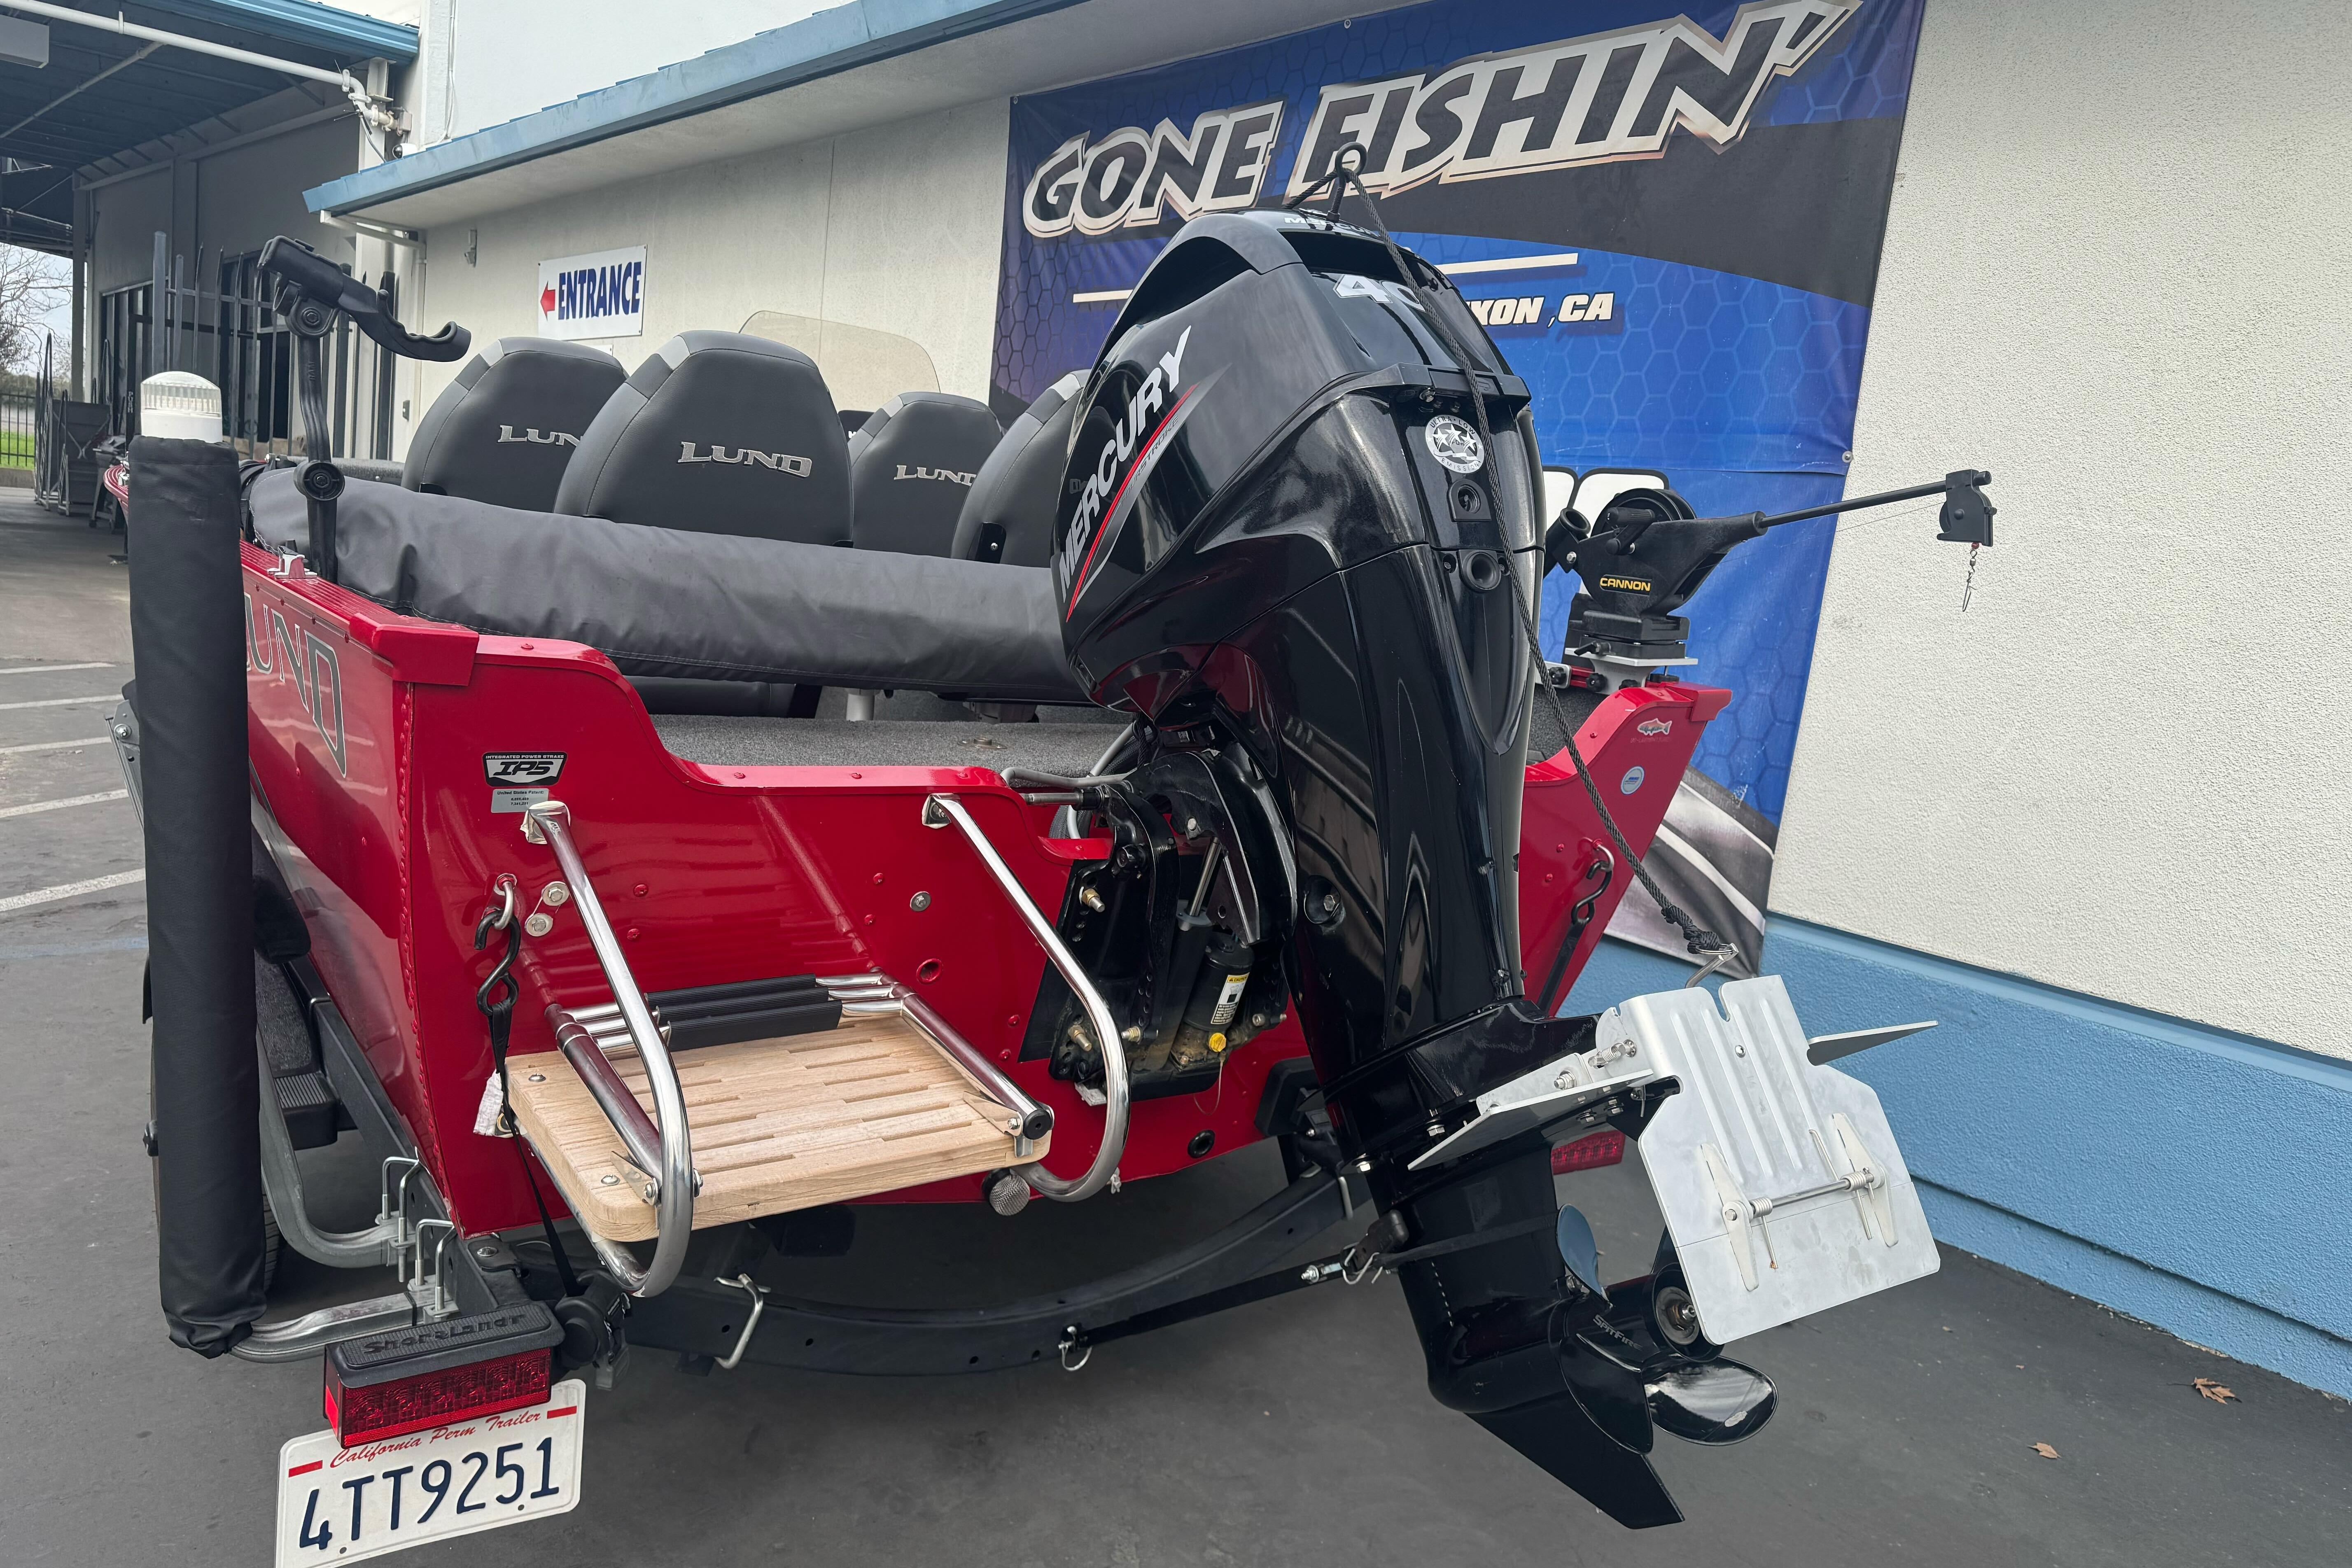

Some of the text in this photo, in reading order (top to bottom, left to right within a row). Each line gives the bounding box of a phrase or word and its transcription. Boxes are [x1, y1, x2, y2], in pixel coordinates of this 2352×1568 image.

[1025, 103, 1283, 234] GONE
[1284, 217, 1380, 238] MERCUR
[558, 261, 642, 320] ENTRANCE
[1465, 297, 1544, 325] XON
[498, 425, 580, 446] LUN
[1430, 415, 1475, 435] ULTRA LOW
[678, 441, 812, 478] LUND
[1059, 325, 1191, 603] MERCURY
[1120, 415, 1178, 505] FOURSTROKE
[1442, 457, 1479, 472] EMISSION
[1600, 577, 1651, 591] CANNON
[247, 592, 346, 778] UND
[493, 761, 554, 776] IPS
[330, 1411, 541, 1469] California Perm Trailer
[299, 1437, 559, 1550] 4TT9251
